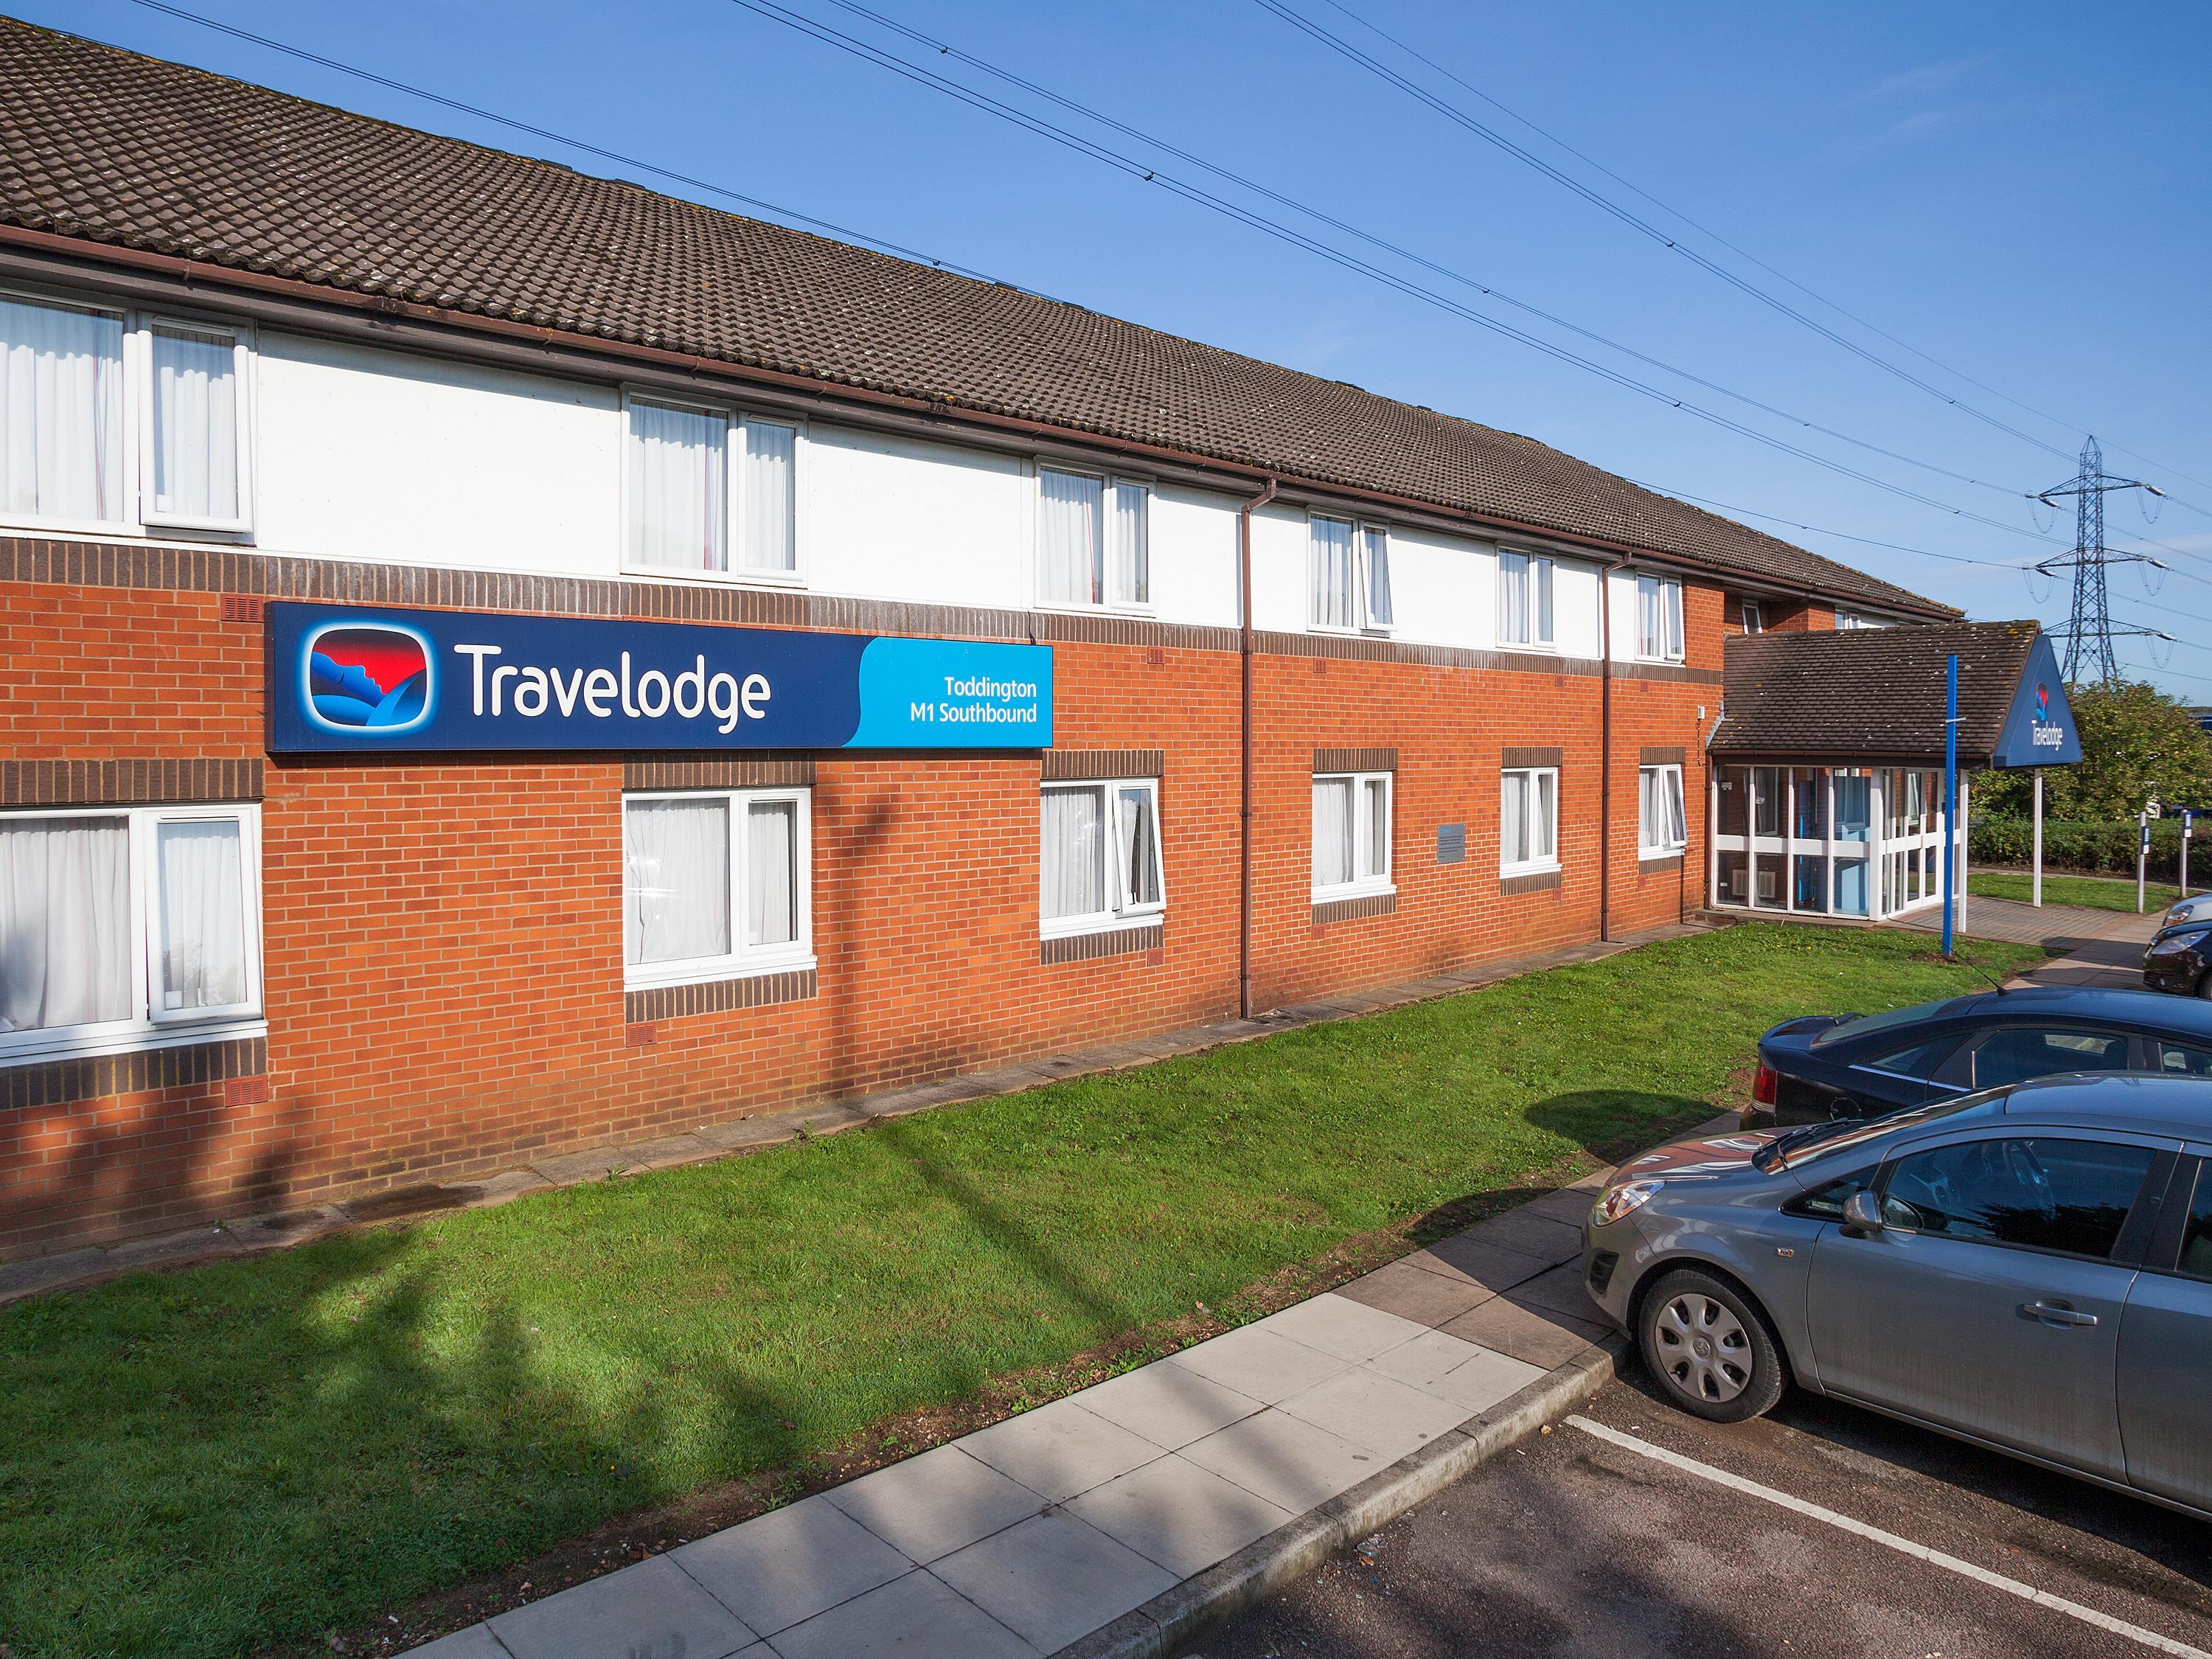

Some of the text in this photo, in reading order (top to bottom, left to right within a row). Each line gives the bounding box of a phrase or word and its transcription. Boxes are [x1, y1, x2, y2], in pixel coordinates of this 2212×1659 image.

[453, 644, 771, 734] Travelodge
[944, 676, 1037, 703] Toddington
[911, 702, 1037, 723] M1 Southbound
[2031, 720, 2063, 751] Travelodge
